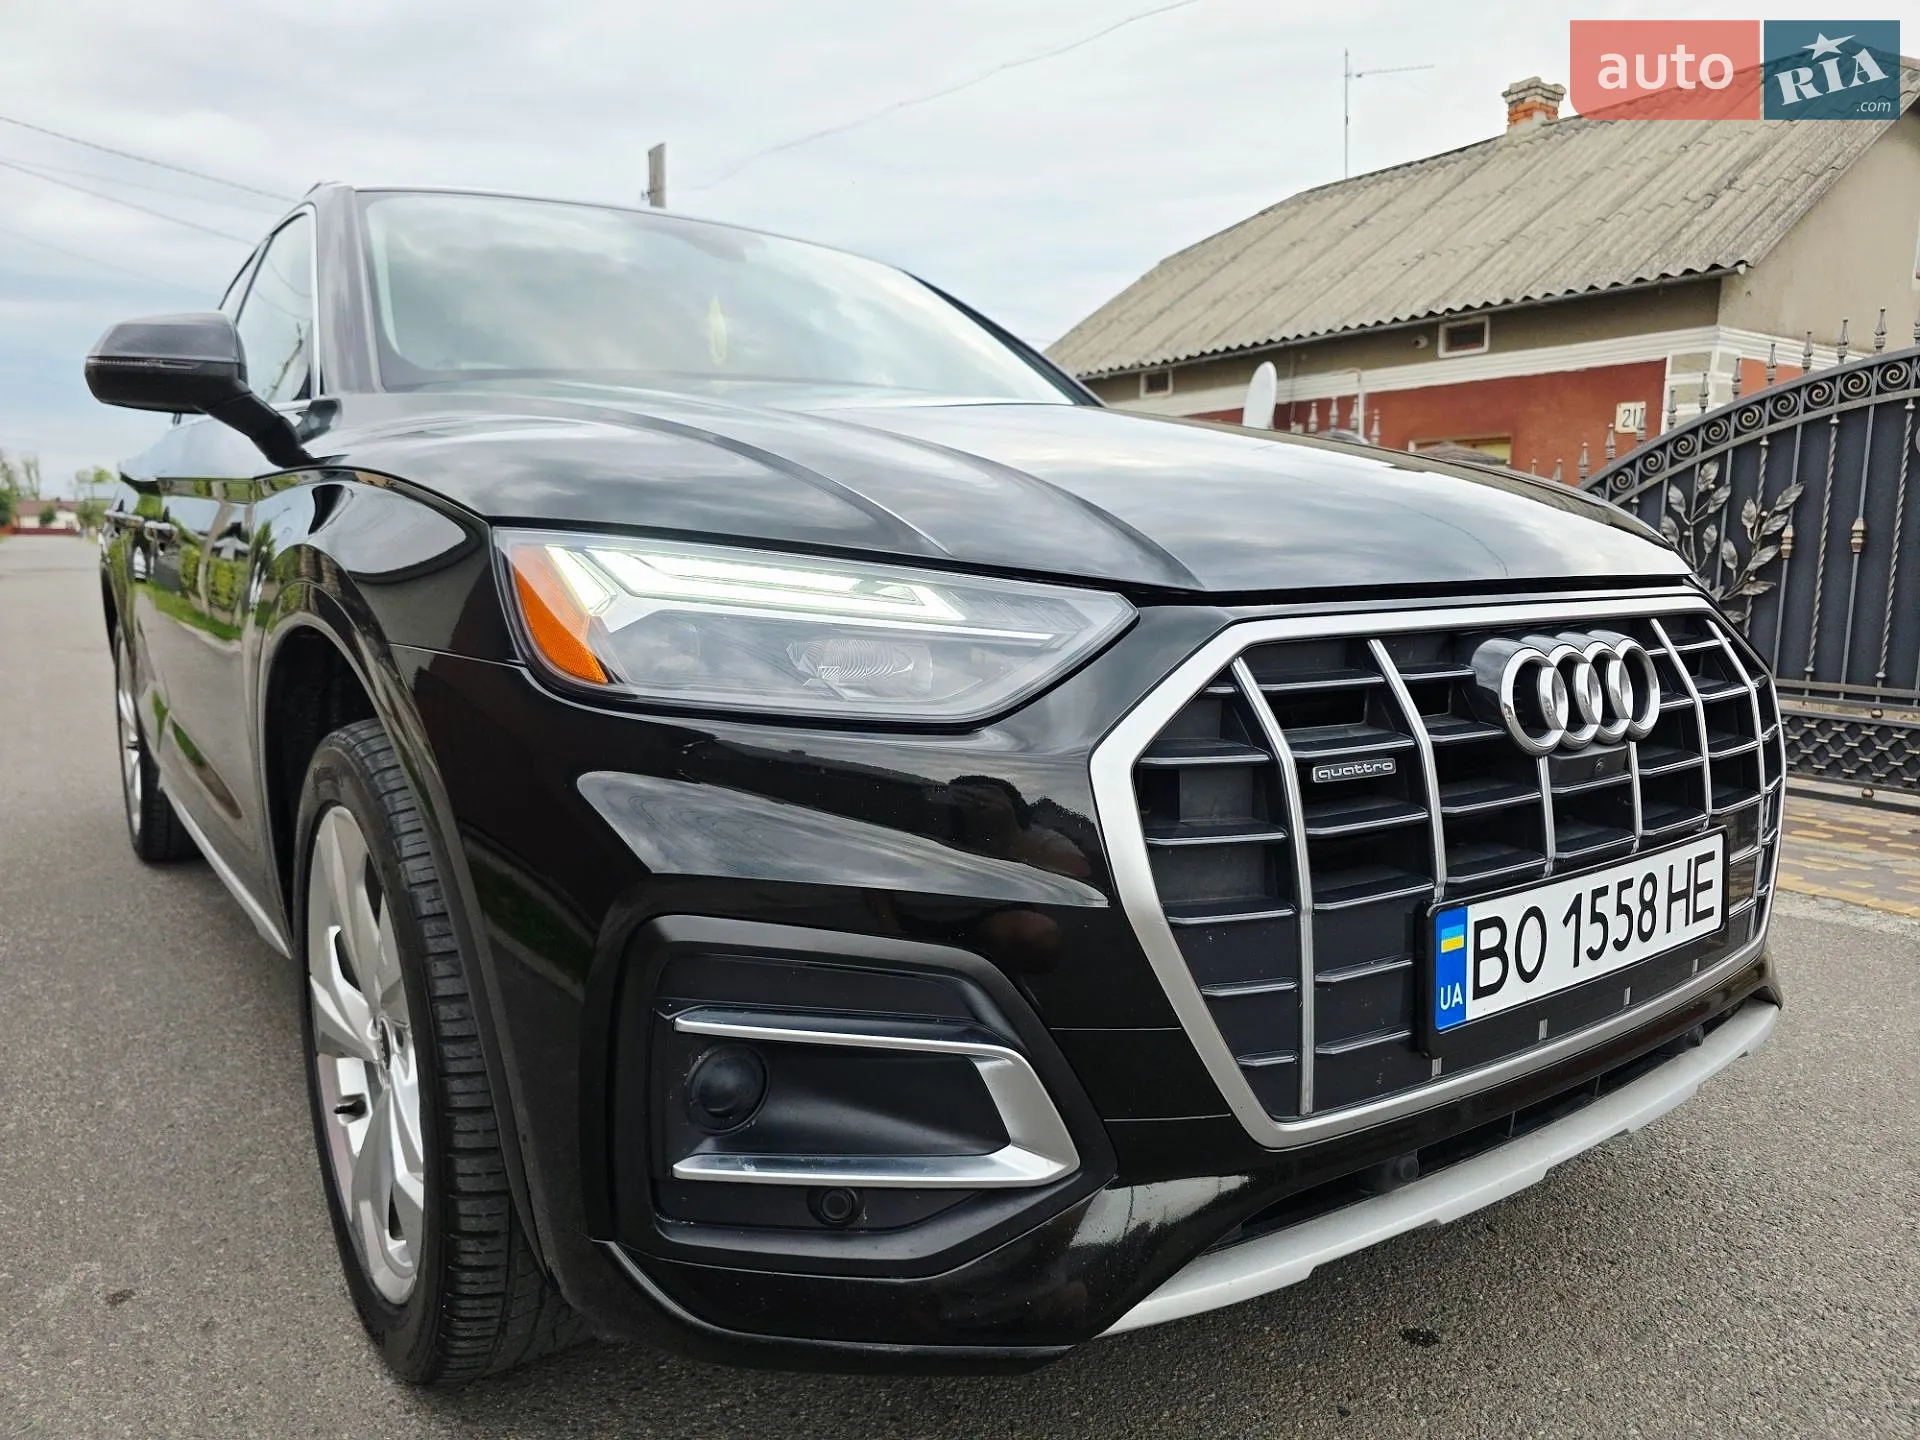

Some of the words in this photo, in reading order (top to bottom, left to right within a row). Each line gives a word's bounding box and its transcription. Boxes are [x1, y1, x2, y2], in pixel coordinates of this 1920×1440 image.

[1318, 762, 1393, 780] quattro
[1472, 905, 1548, 1001] BO
[1562, 871, 1658, 968] 1558
[1665, 850, 1715, 934] HE
[1440, 982, 1463, 1011] UA
